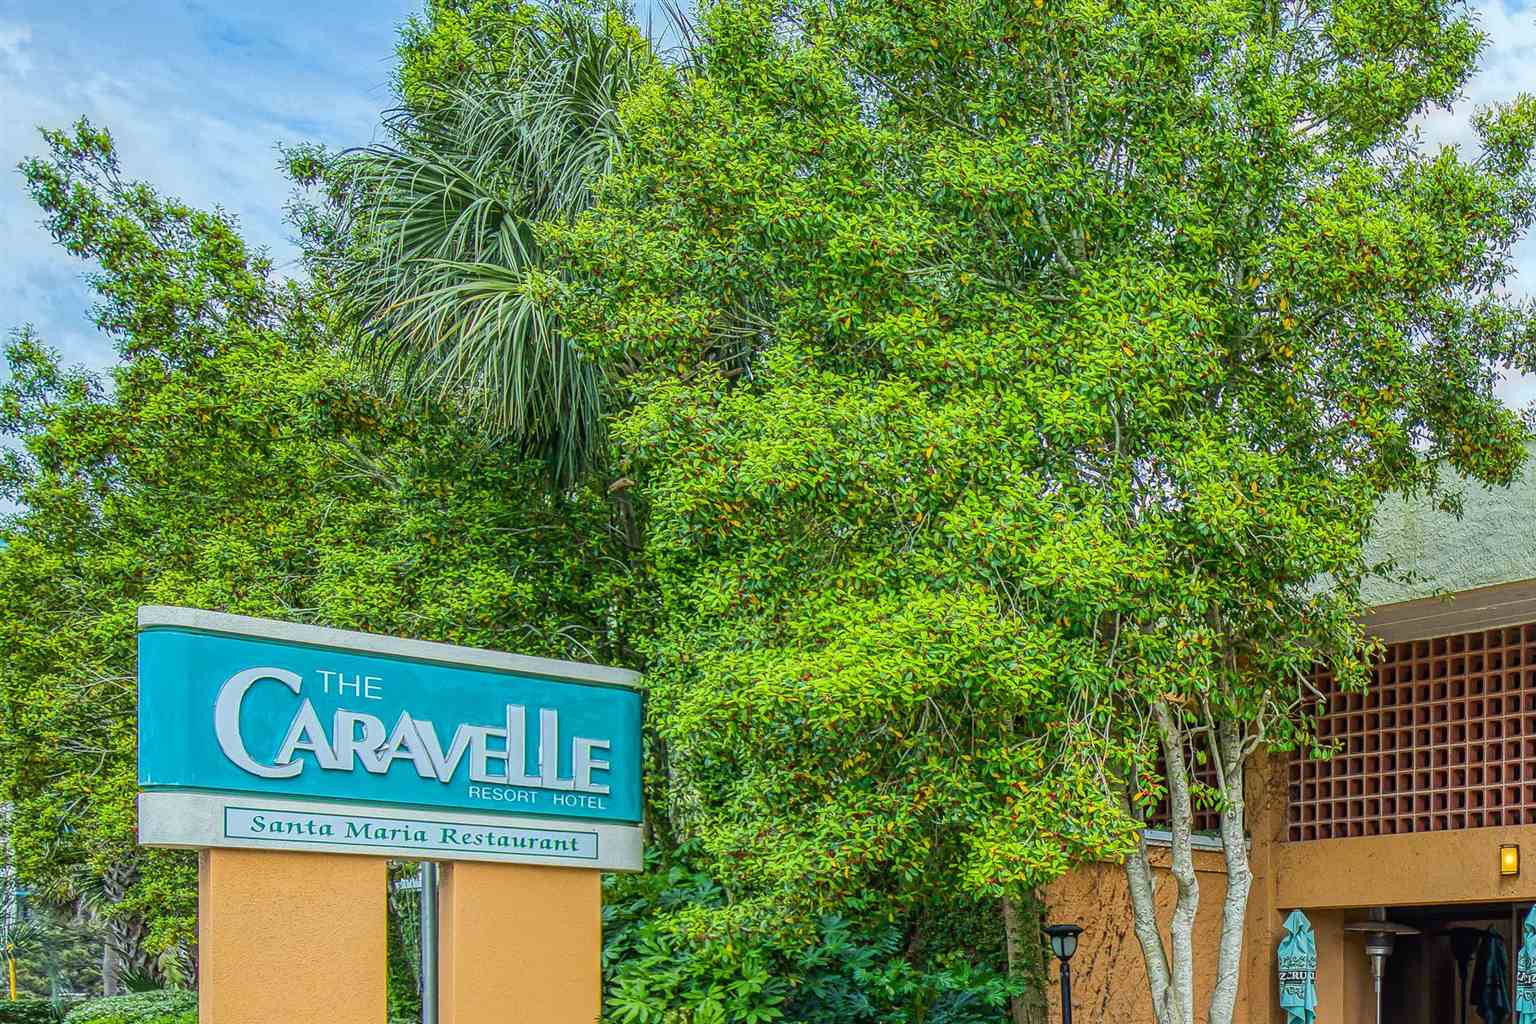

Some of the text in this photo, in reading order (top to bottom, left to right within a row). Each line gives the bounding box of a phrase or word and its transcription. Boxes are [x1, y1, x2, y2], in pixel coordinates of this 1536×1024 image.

[316, 669, 384, 700] THE
[214, 666, 610, 794] CARAVELLE
[468, 785, 608, 810] RESORT HOTEL
[250, 815, 580, 852] Santa Maria Restaurant
